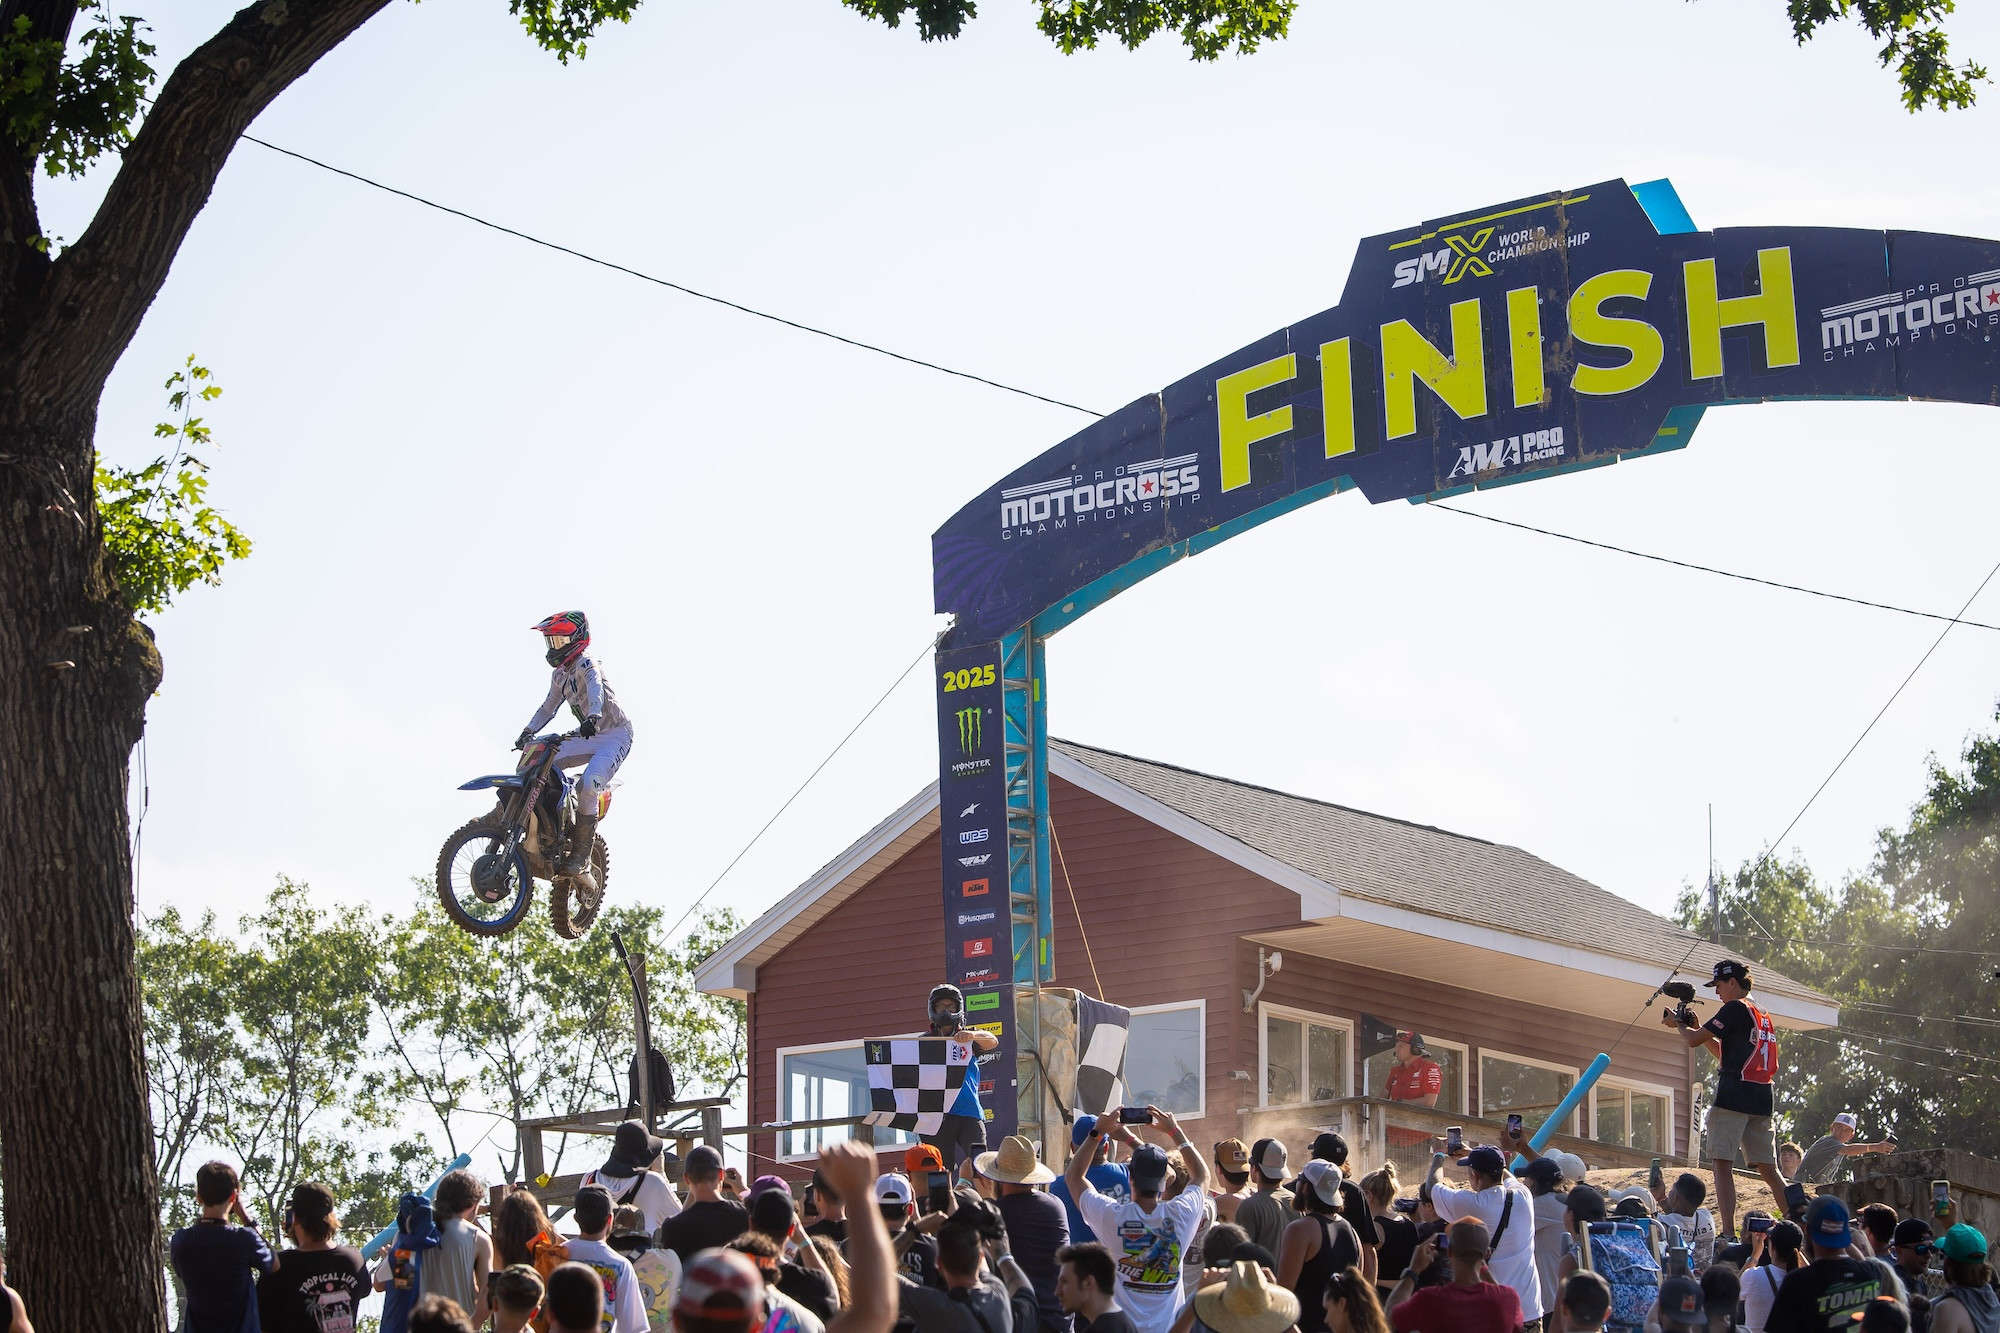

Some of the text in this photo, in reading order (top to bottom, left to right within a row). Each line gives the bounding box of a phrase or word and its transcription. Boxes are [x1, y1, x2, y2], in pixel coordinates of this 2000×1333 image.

[1499, 226, 1546, 247] WORLD
[1391, 227, 1495, 288] SMX
[1905, 277, 1965, 299] PRO
[1821, 282, 2000, 350] MOTOCRO
[1823, 313, 2000, 362] CHAMPIONS
[1215, 246, 1801, 494] FINISH
[1522, 427, 1564, 452] PRO
[1447, 436, 1521, 479] AMA
[1523, 446, 1565, 462] RACING
[1074, 466, 1125, 485] PRO
[1001, 465, 1200, 529] MOTOCROSS
[1002, 493, 1201, 540] CHAMPIONSHIP
[943, 664, 996, 692] 2025
[952, 759, 991, 772] MONSTER
[960, 829, 989, 844] WPS
[958, 853, 992, 865] FLY
[968, 884, 985, 892] KTM
[964, 912, 995, 923] Husqvarna
[966, 969, 990, 978] MX-ATV
[970, 998, 996, 1007] Kawasaki
[1119, 1264, 1144, 1279] THE
[299, 1272, 359, 1294] TROPICAL LIFE
